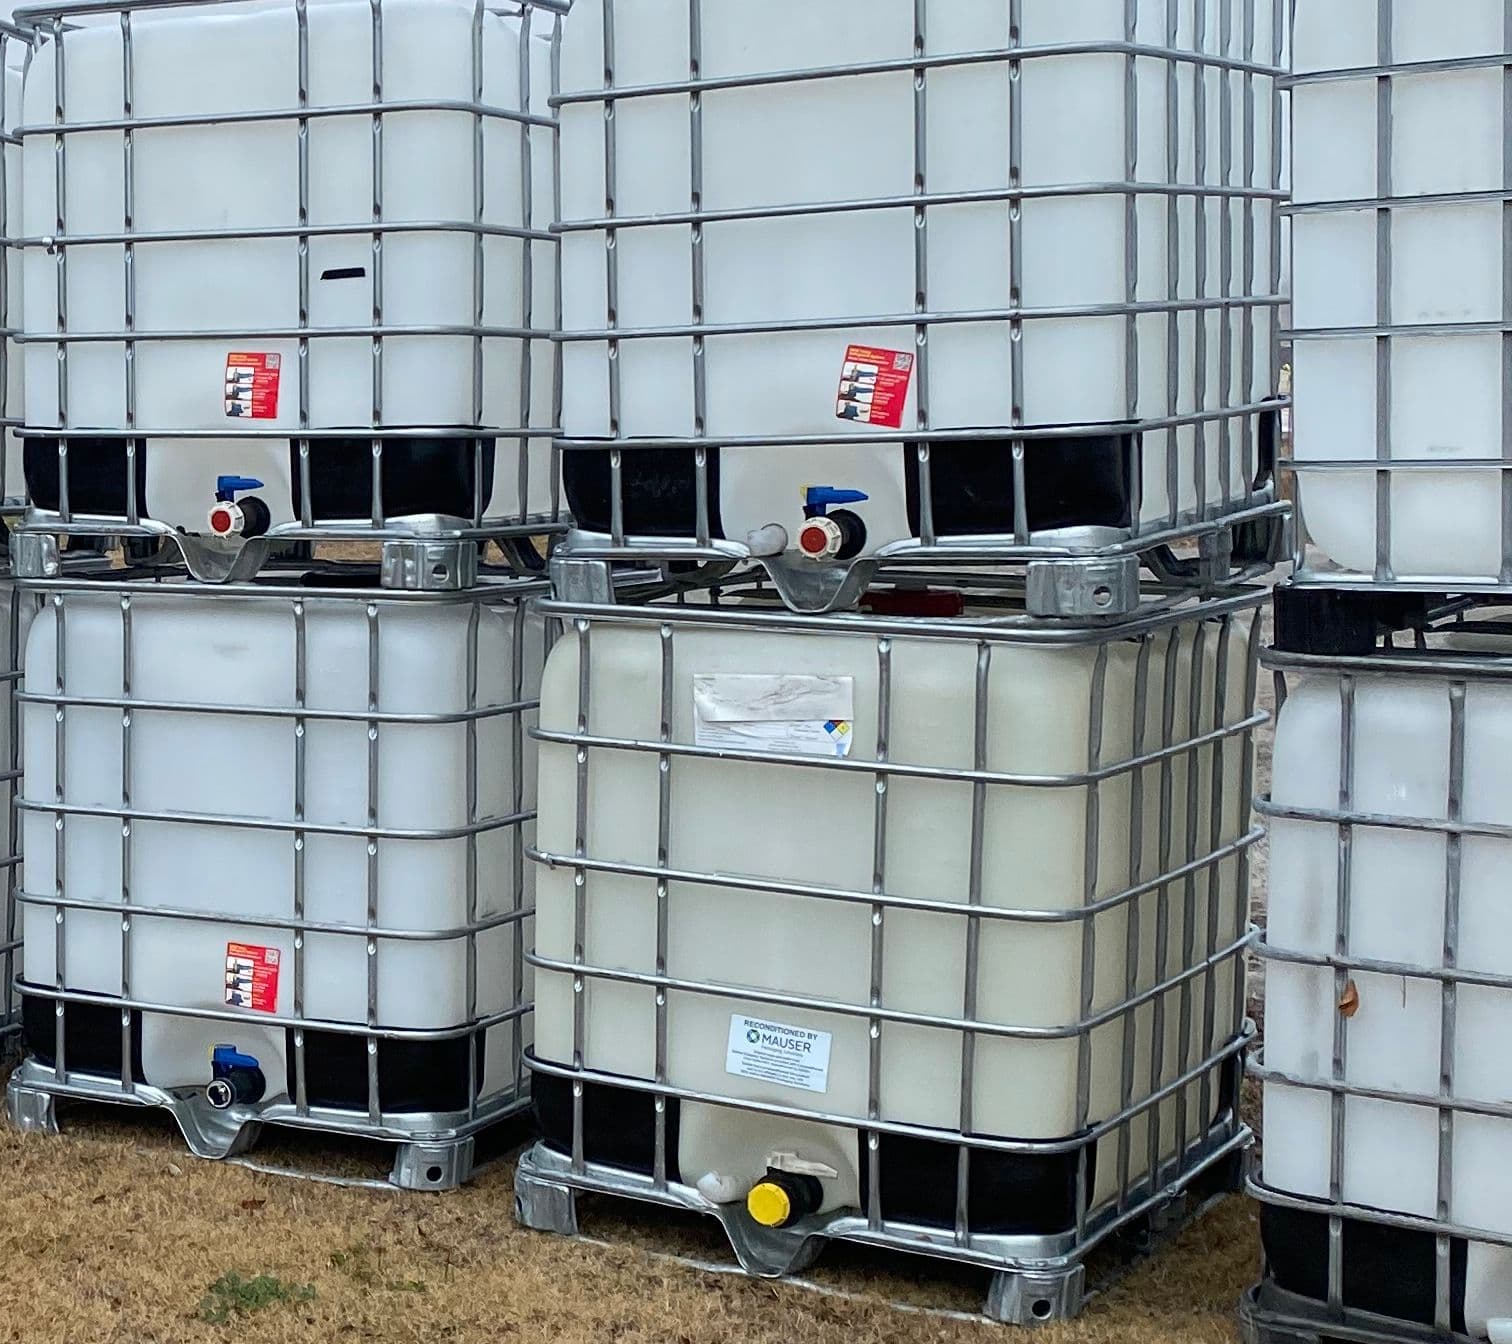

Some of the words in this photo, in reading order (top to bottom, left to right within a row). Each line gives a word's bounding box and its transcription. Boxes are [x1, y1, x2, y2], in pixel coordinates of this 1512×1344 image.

[743, 1019, 806, 1038] RECONDITIONED
[807, 1033, 818, 1041] BY
[761, 1033, 812, 1054] MAUSER
